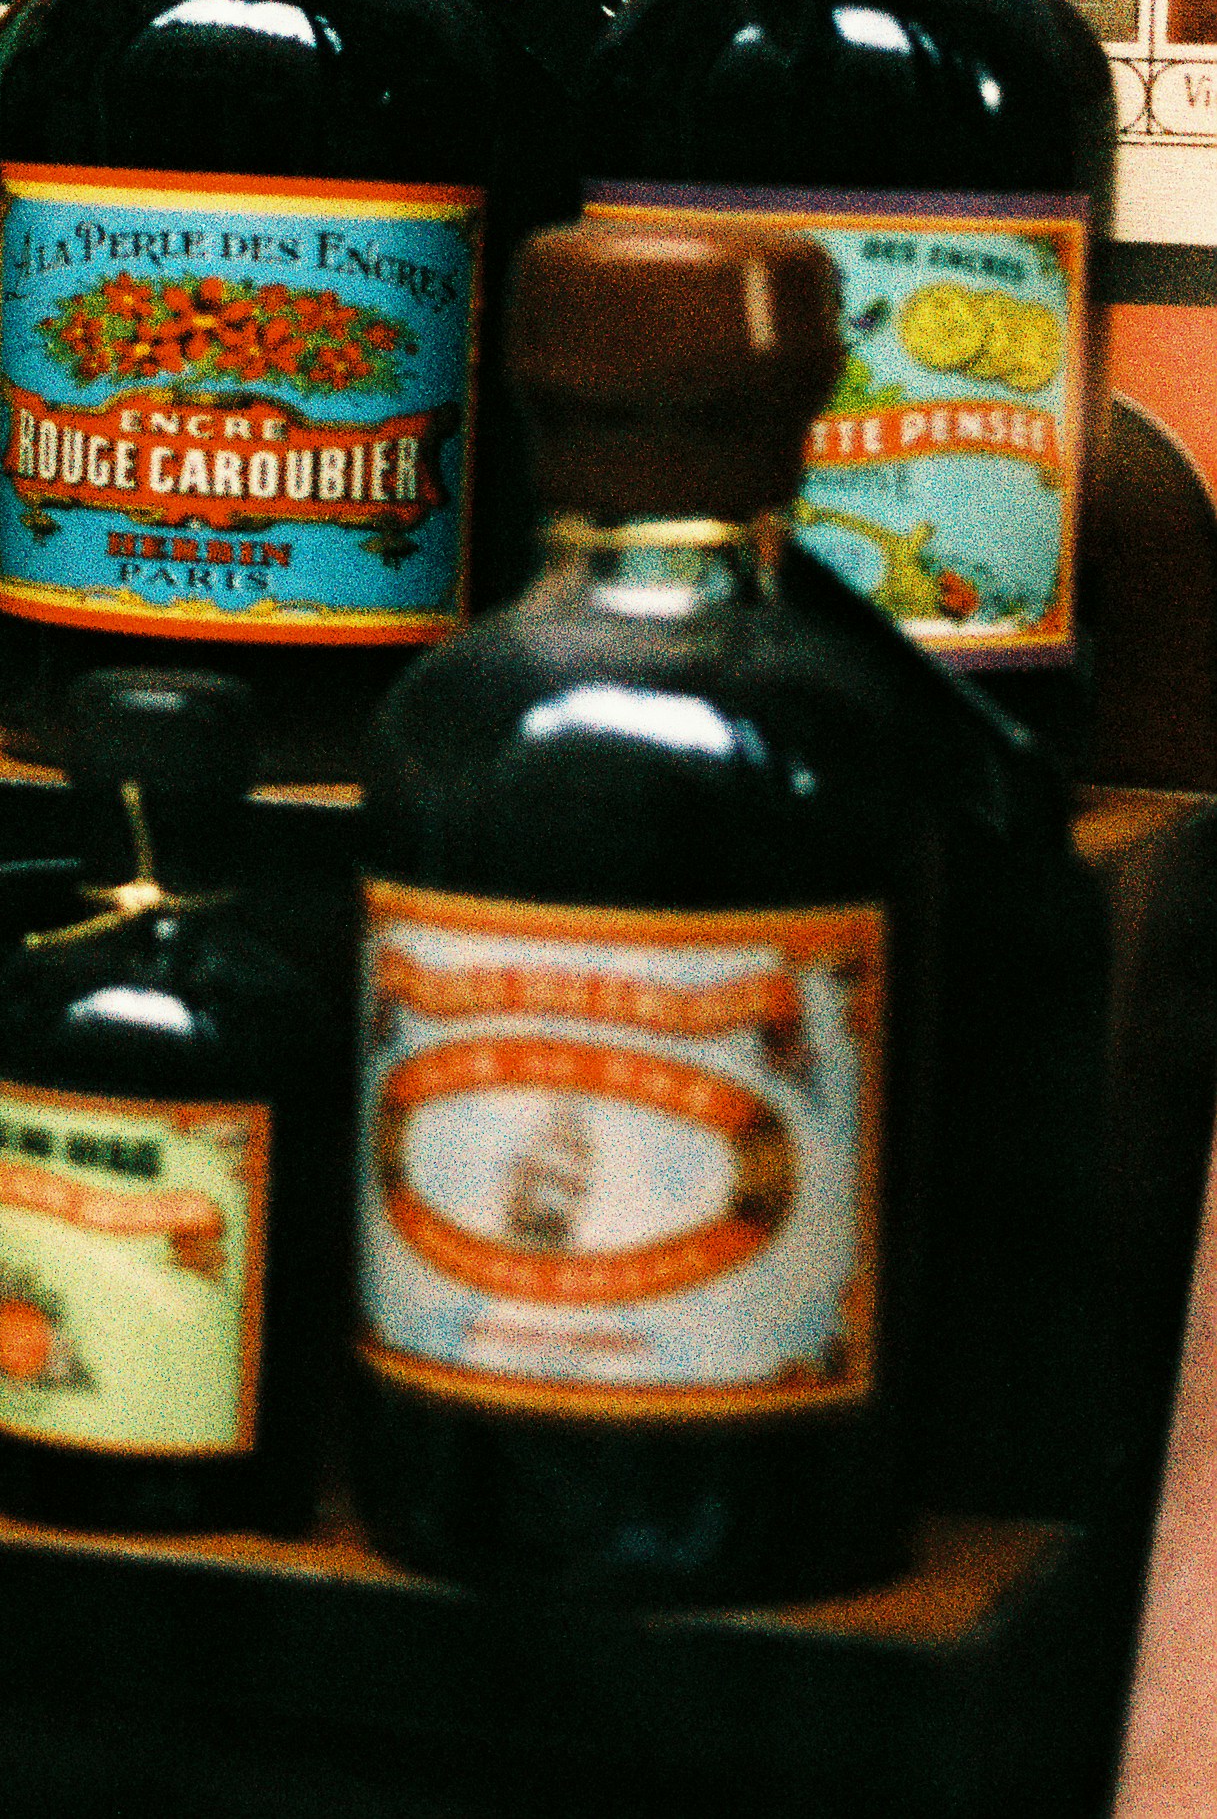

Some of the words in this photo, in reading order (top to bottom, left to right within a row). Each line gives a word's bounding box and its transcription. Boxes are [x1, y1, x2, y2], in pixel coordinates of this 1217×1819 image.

[117, 408, 289, 442] ENCRE
[16, 407, 139, 490] ROUGE
[148, 435, 421, 503] CAROUBIER
[105, 530, 293, 570] HERBIN
[119, 562, 272, 593] PARIS
